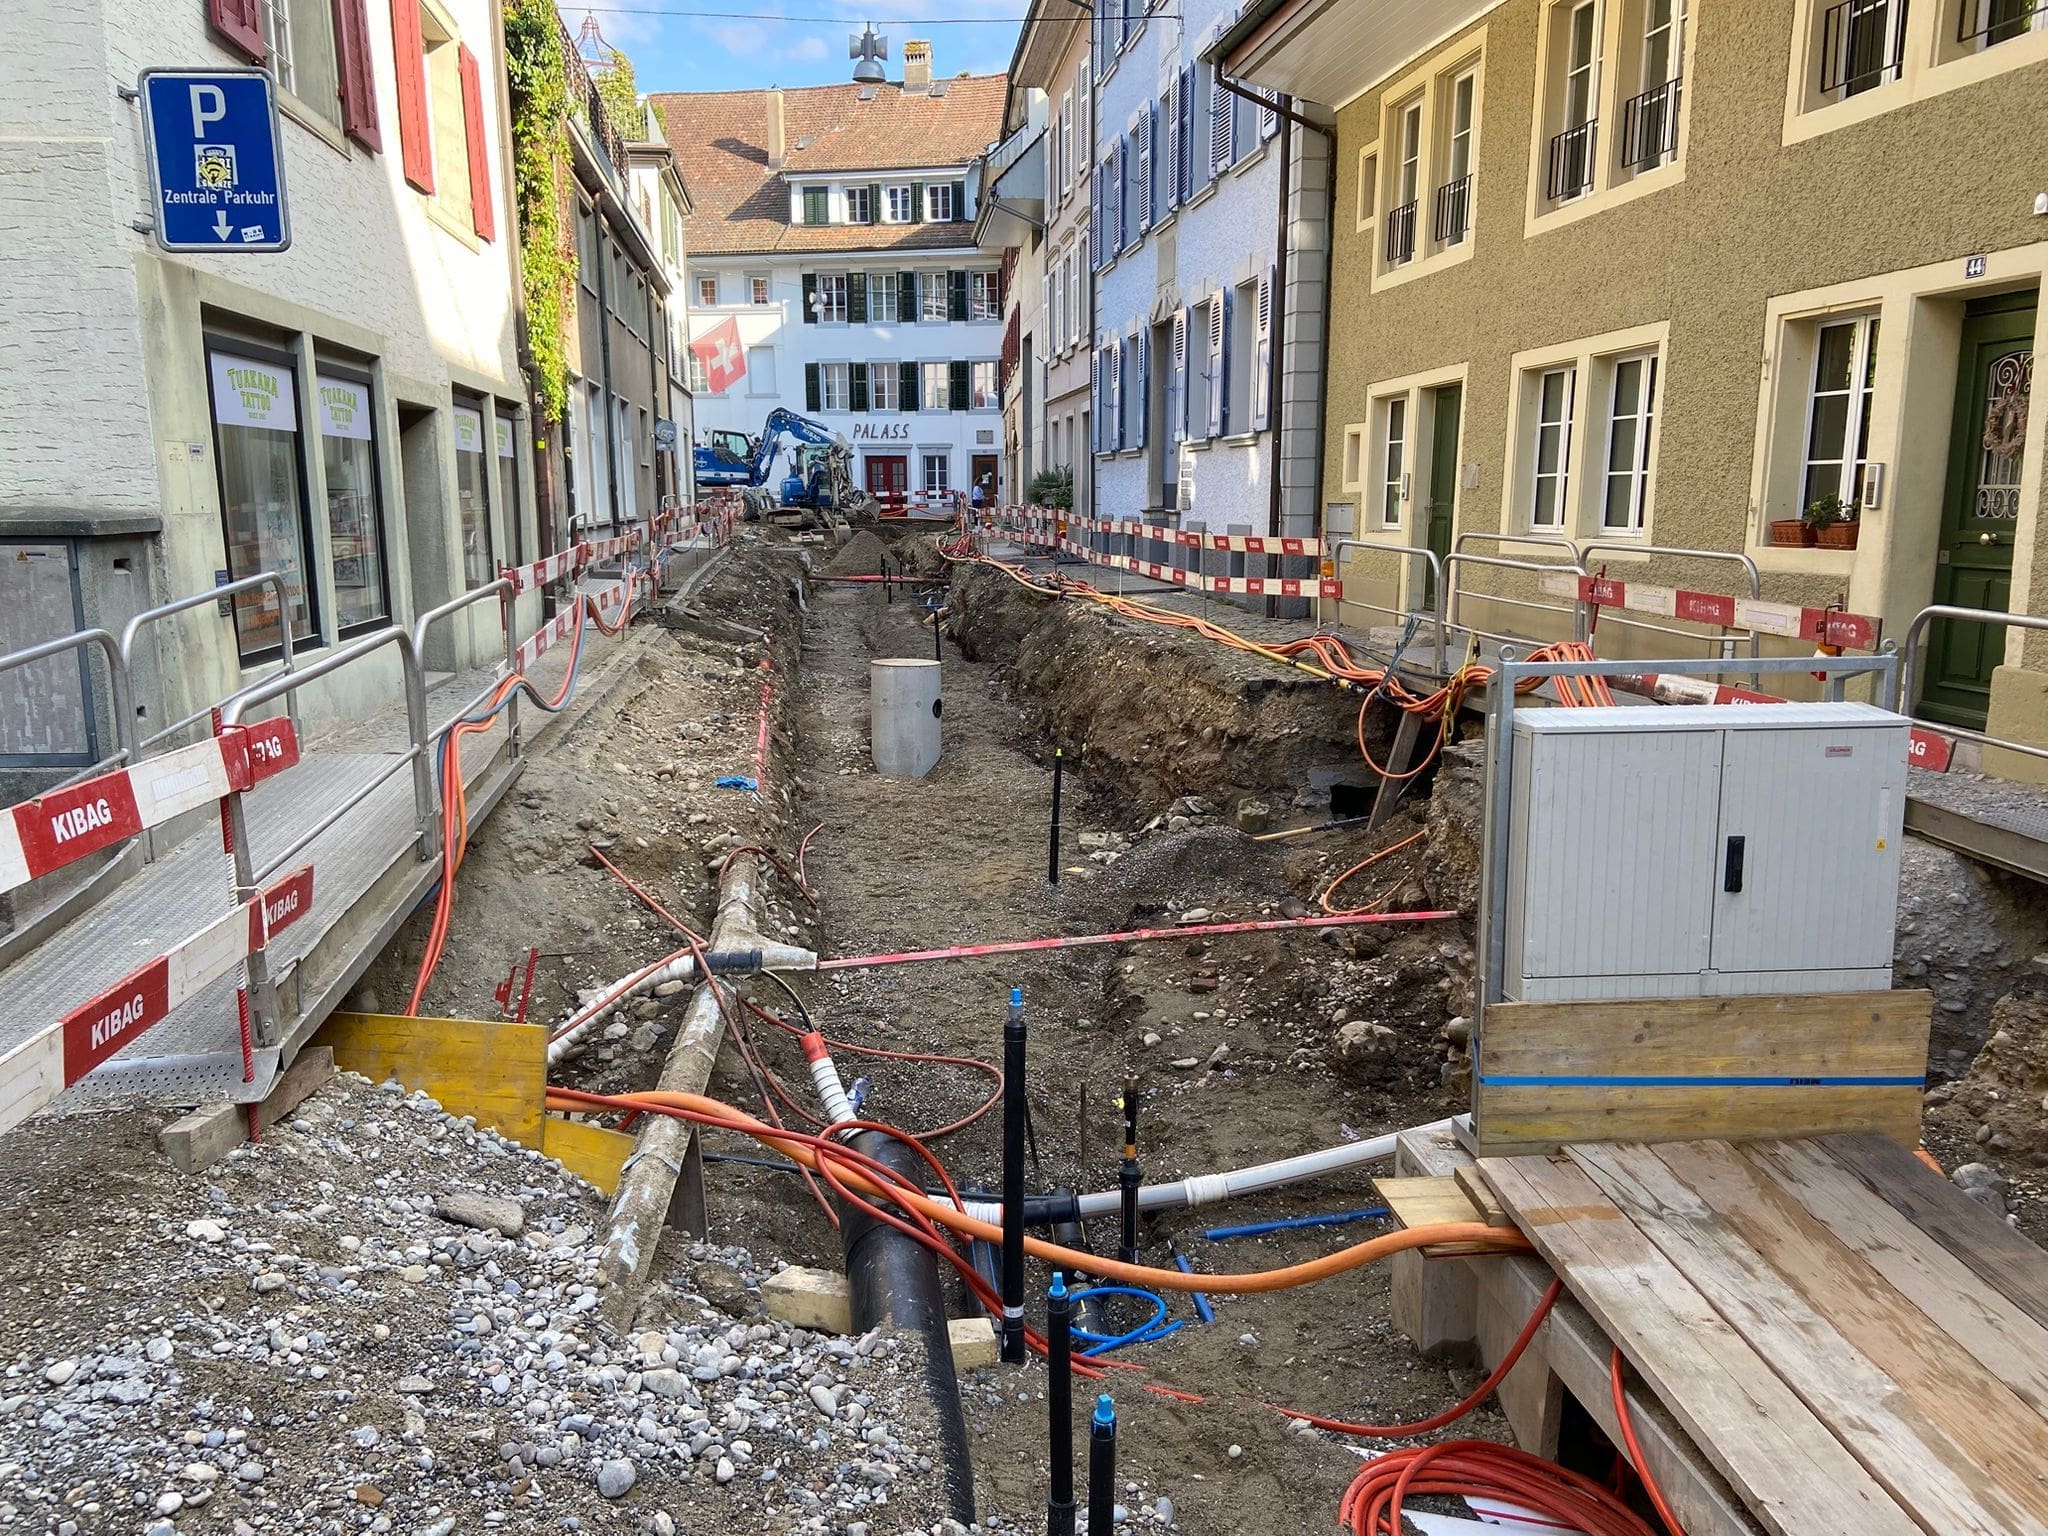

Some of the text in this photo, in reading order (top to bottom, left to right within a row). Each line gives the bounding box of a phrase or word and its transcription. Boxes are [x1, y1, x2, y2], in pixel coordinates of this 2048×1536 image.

[189, 84, 226, 138] P
[164, 189, 275, 205] Zentrale Parkuhr
[1968, 258, 1983, 275] 44
[240, 390, 271, 411] TATTOO
[853, 423, 910, 439] PALASS
[52, 798, 112, 844] KIBAG
[266, 889, 298, 926] KIBAG
[91, 993, 144, 1051] KIBAG
